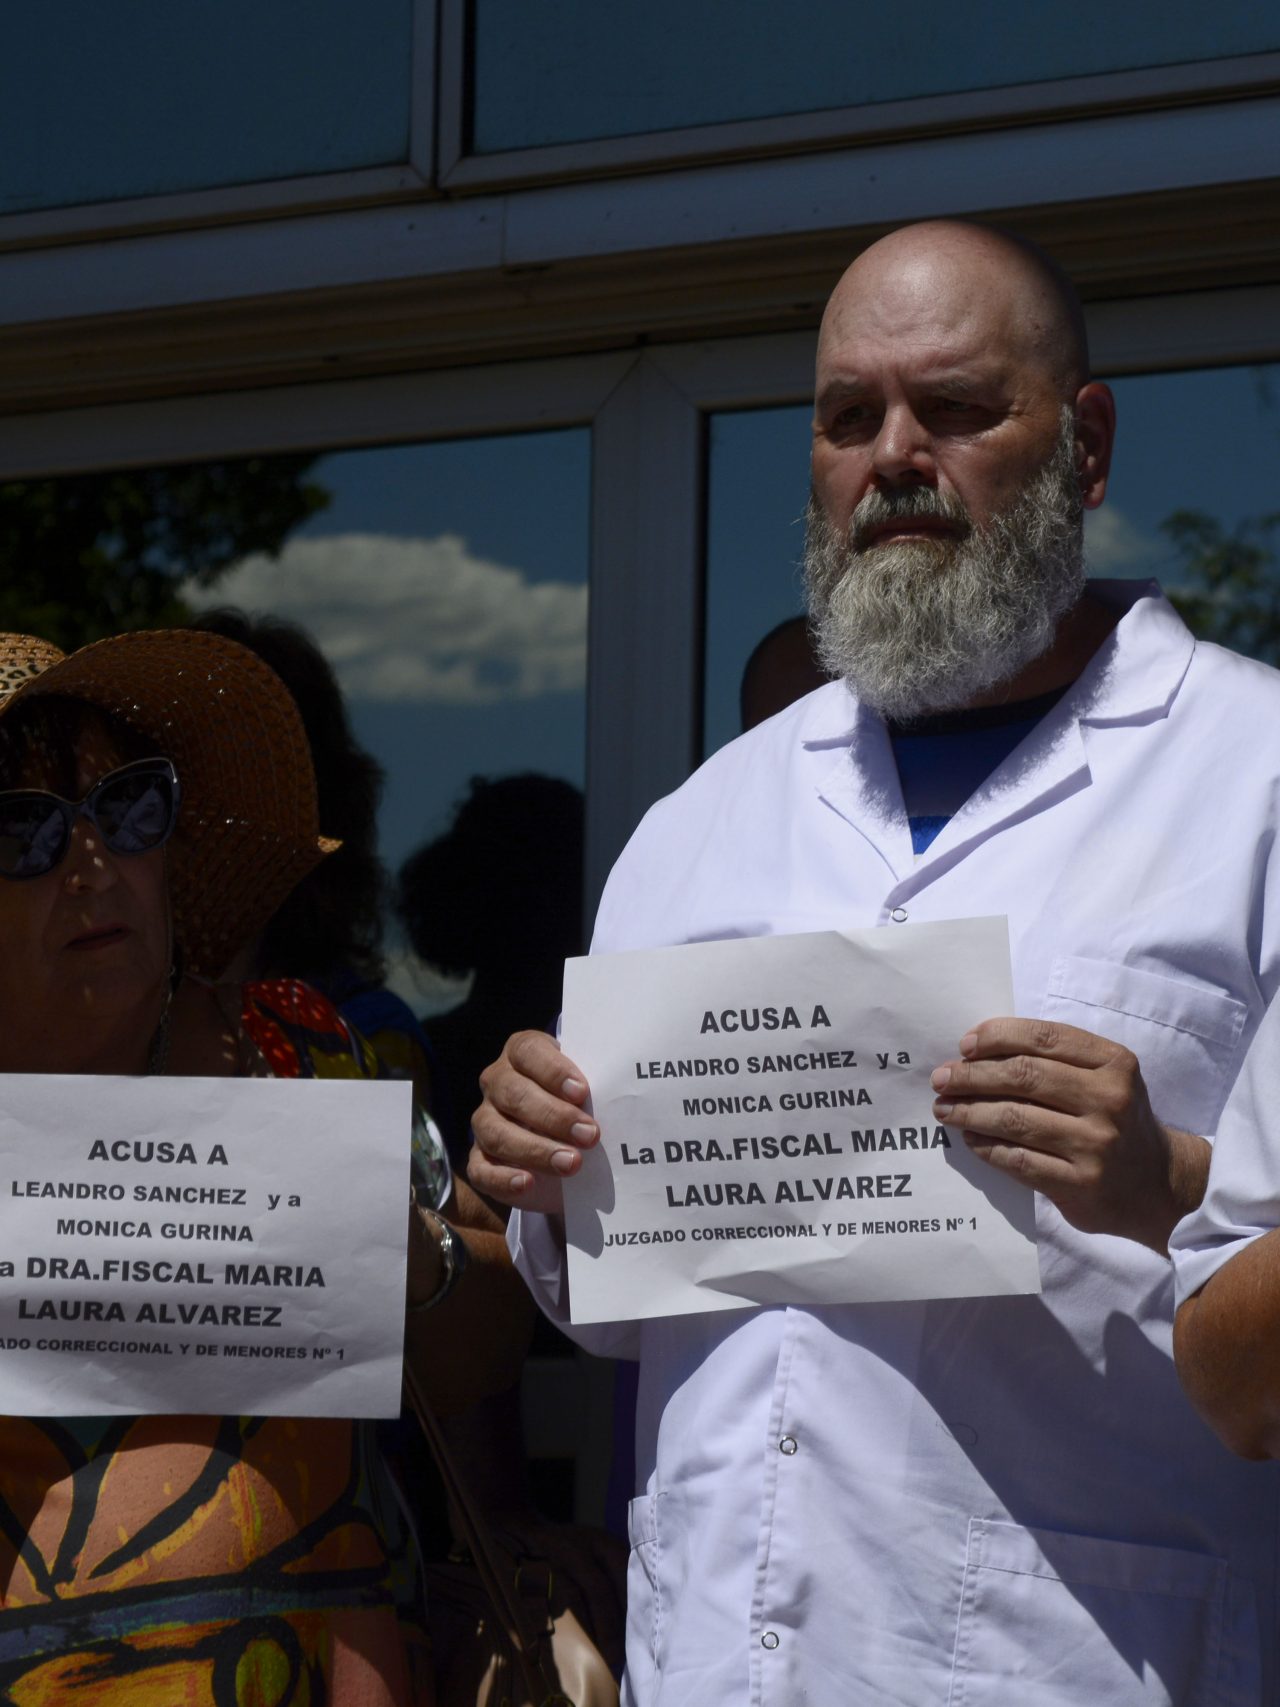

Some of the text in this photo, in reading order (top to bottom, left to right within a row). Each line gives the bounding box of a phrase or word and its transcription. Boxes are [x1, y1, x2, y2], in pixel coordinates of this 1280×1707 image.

[700, 1005, 832, 1034] ACUSA A
[635, 1050, 911, 1080] LEANDRO SANCHEZ y a
[682, 1088, 873, 1116] MONICA GURINA
[87, 1139, 229, 1166] ACUSA A
[620, 1125, 952, 1166] La DRA.FISCAL MARIA
[11, 1180, 301, 1211] LEANDRO SANCHEZ y a
[665, 1173, 913, 1208] LAURA ALVAREZ
[56, 1218, 254, 1242] MONICA GURINA
[604, 1229, 686, 1248] JUZGADO
[691, 1223, 818, 1242] CORRECCIONAL
[821, 1223, 832, 1237] Y
[837, 1222, 857, 1236] DE
[861, 1218, 941, 1235] MENORES
[969, 1216, 977, 1231] 1
[26, 1256, 214, 1284] DRA.FISCAL
[224, 1263, 326, 1288] MARIA
[18, 1299, 283, 1328] LAURA ALVAREZ
[36, 1338, 174, 1355] CORRECCIONAL
[179, 1343, 191, 1356] Y
[195, 1343, 219, 1357] DE
[223, 1344, 308, 1359] MENORES
[336, 1348, 345, 1361] 1
